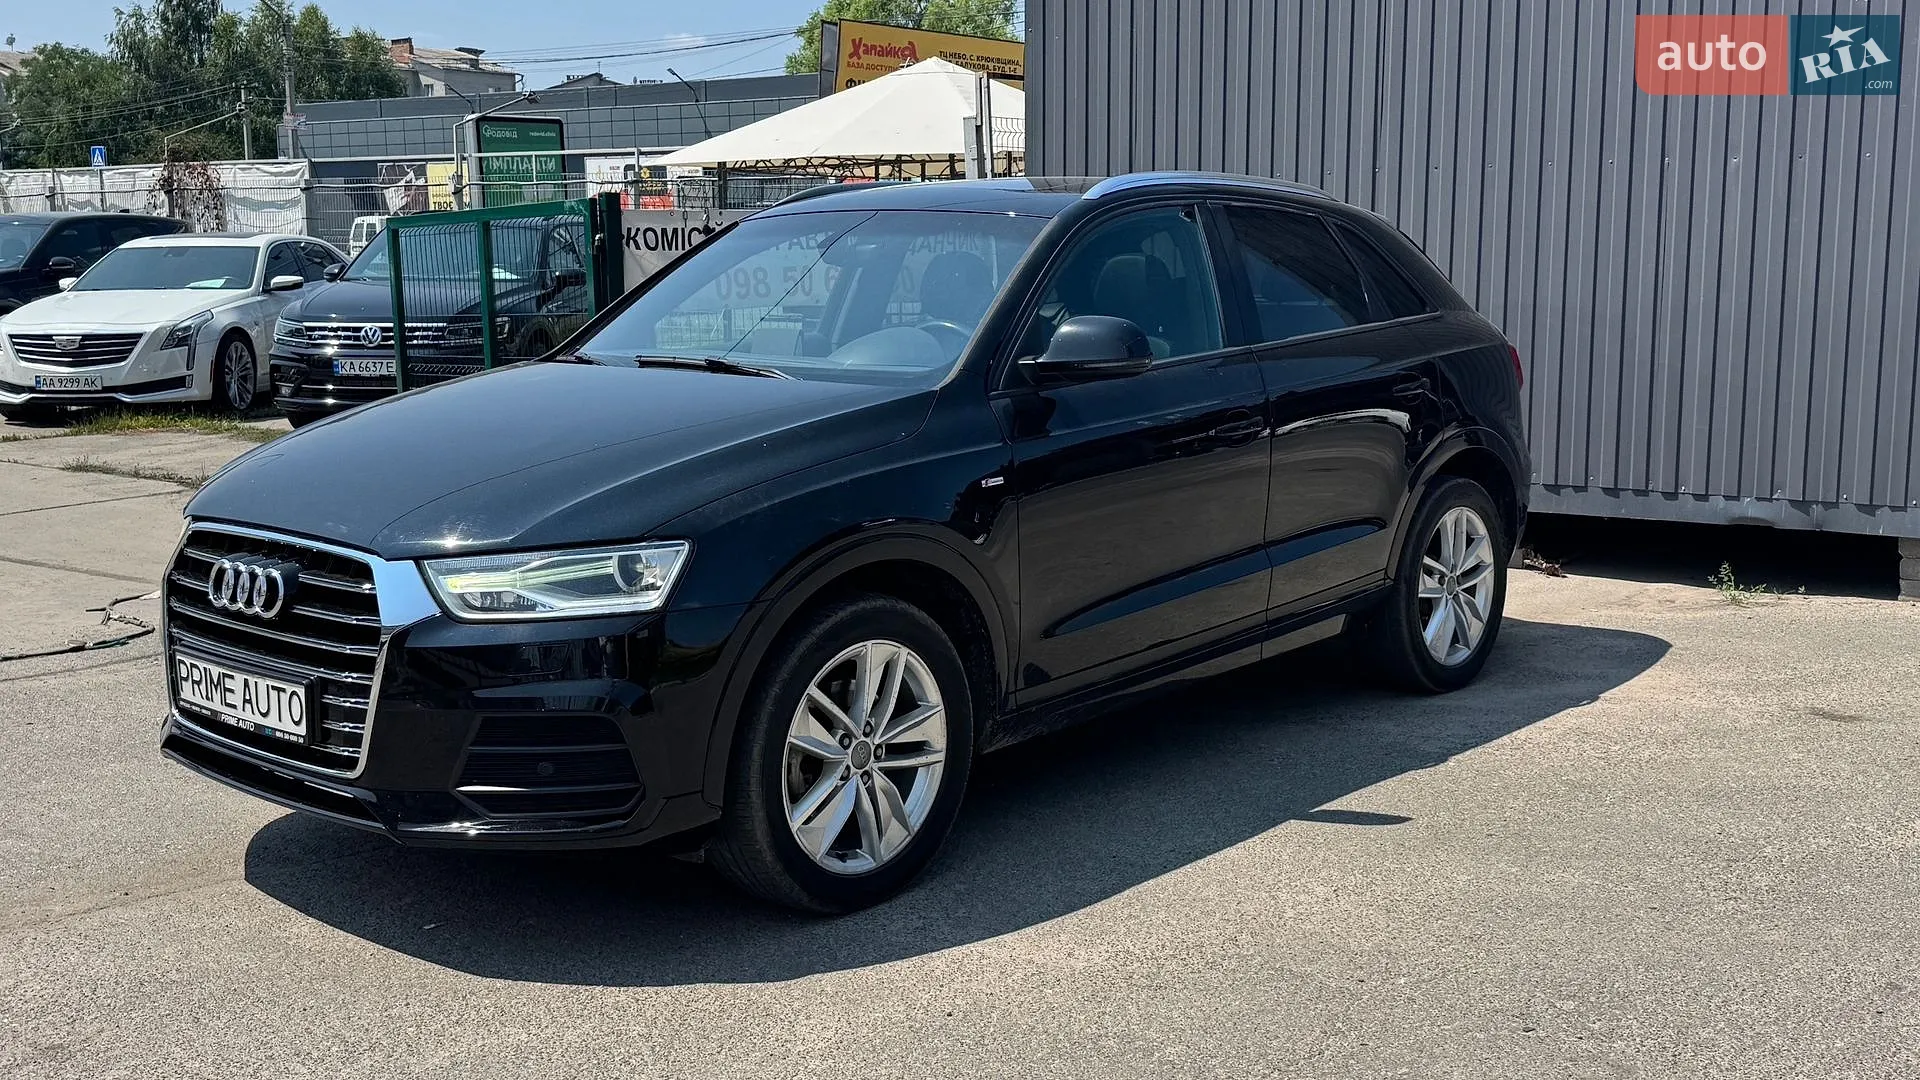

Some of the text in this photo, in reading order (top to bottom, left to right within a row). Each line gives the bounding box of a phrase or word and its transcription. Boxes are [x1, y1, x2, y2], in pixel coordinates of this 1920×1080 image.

[847, 61, 864, 69] БАЗА
[359, 361, 383, 372] 6637
[57, 377, 80, 388] 9299
[177, 658, 304, 726] PRIME AUTO
[220, 713, 239, 727] PRIME
[238, 718, 255, 732] AUTO
